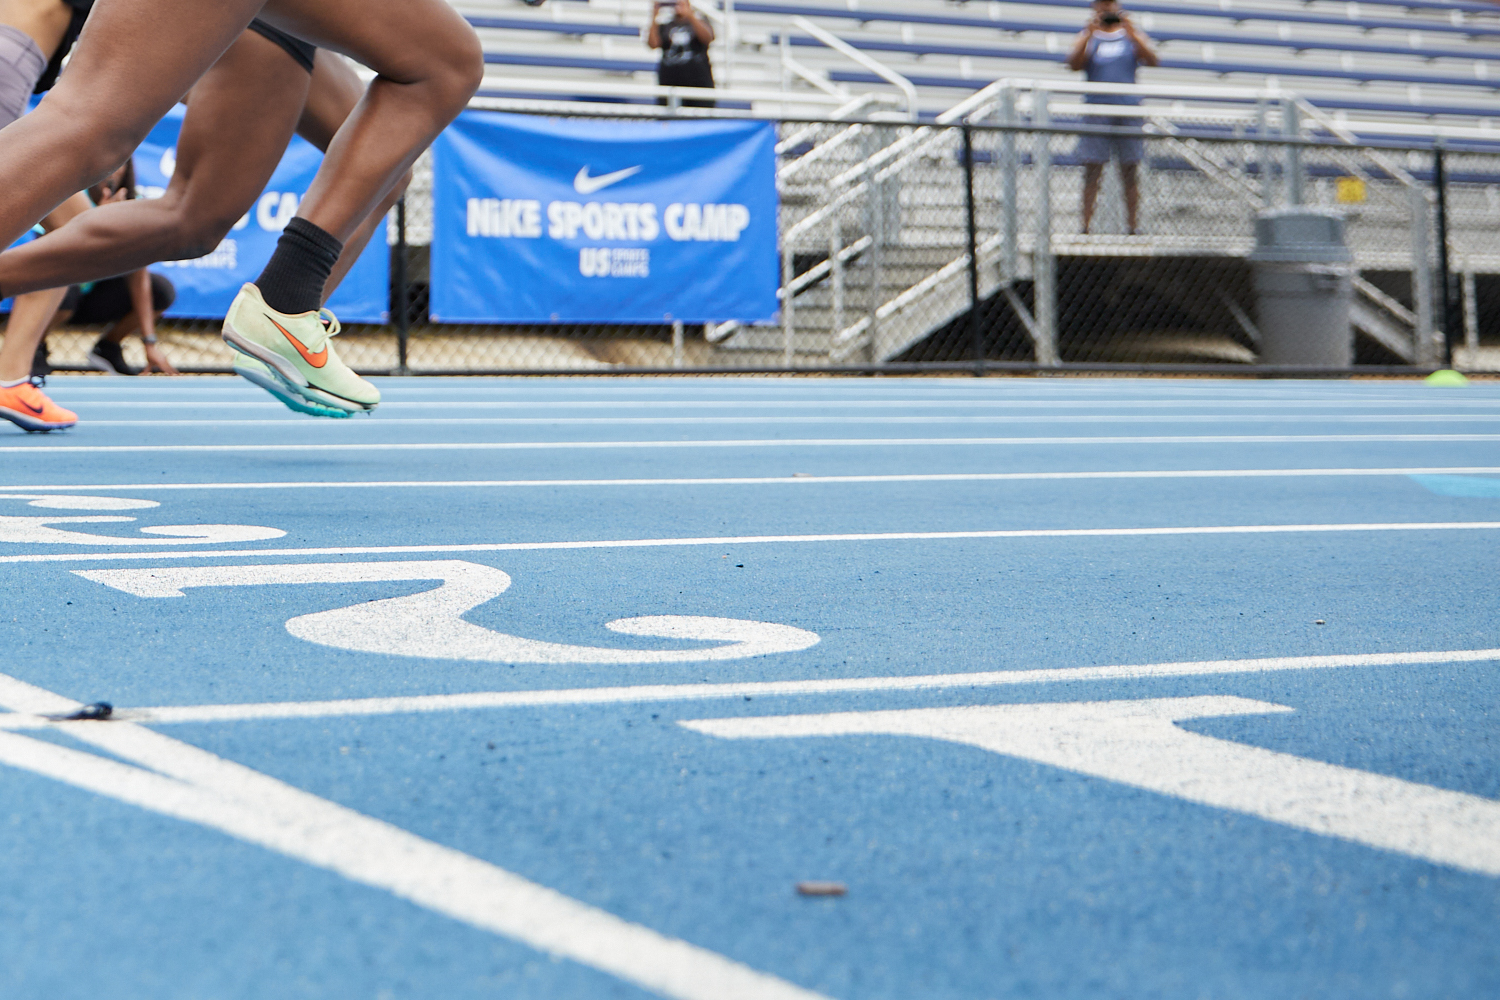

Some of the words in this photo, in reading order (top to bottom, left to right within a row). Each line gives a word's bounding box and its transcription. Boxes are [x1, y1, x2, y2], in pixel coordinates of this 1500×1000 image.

[547, 200, 660, 241] SPORTS
[664, 202, 751, 242] CAMP
[579, 247, 611, 278] US
[71, 559, 821, 664] 2
